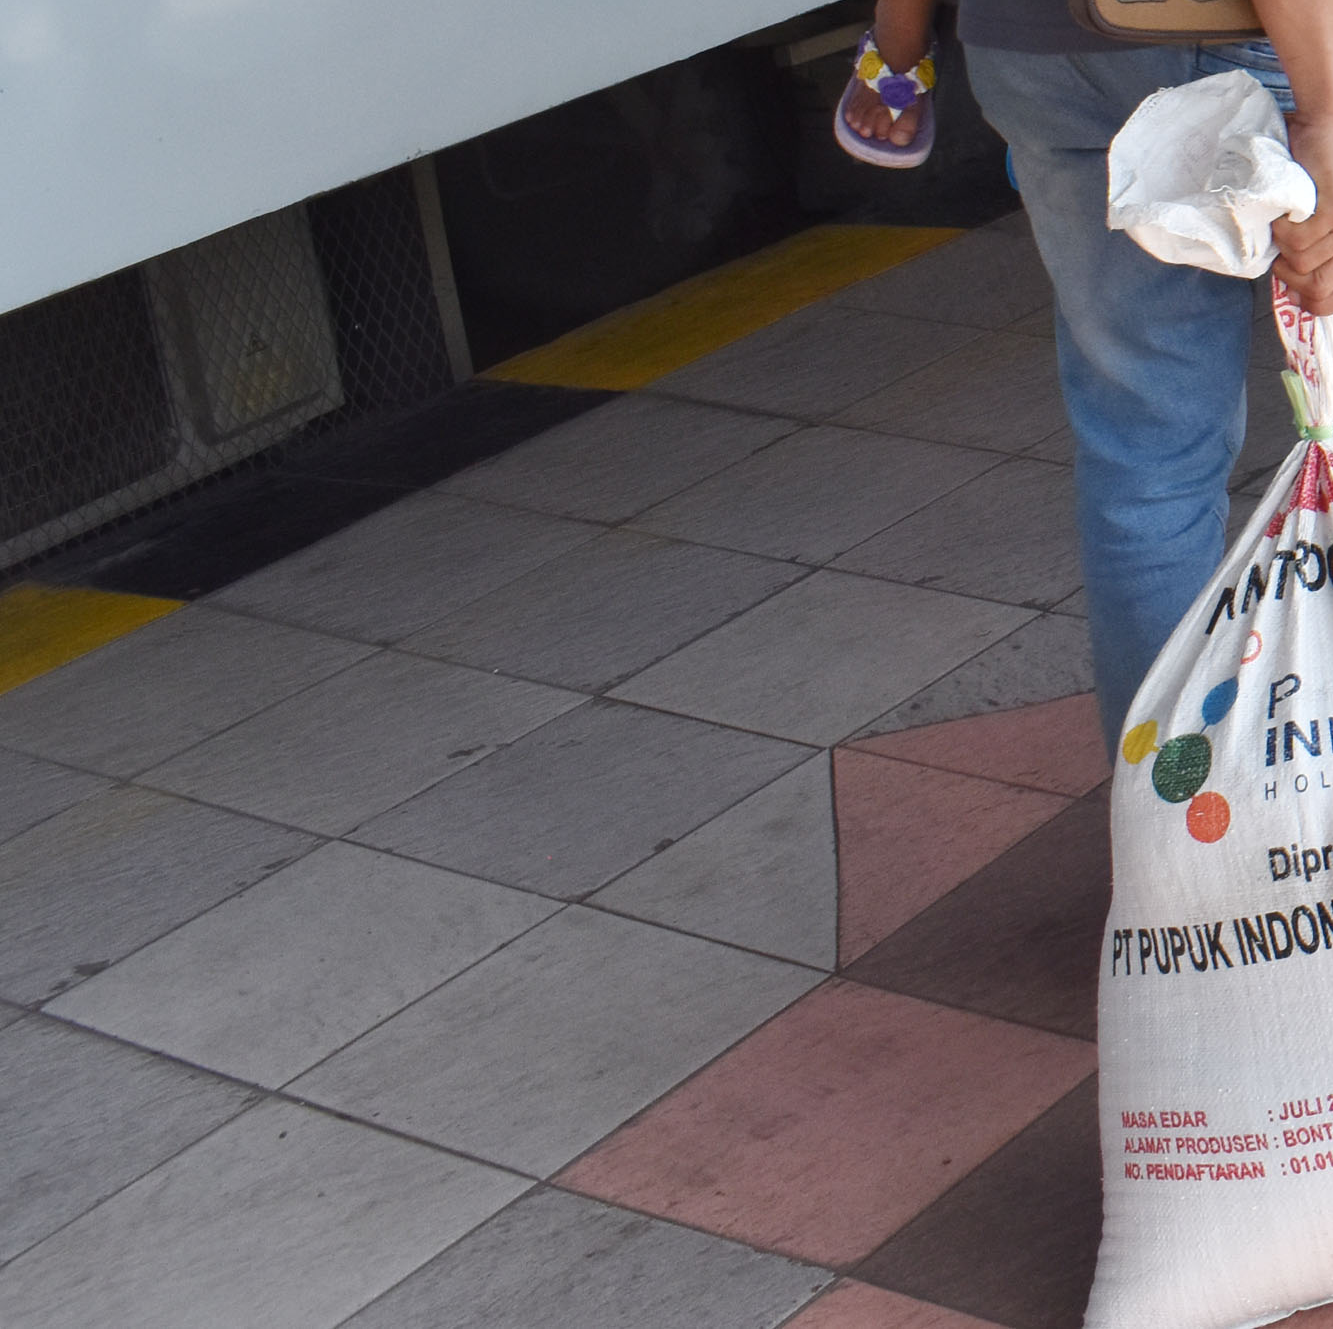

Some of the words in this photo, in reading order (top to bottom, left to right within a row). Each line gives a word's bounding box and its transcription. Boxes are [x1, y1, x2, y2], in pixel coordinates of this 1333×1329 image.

[1112, 928, 1133, 977] PT
[1138, 920, 1235, 976] PUPUK
[1121, 1110, 1158, 1129] MASA
[1161, 1110, 1208, 1129] EDAR
[1279, 1098, 1323, 1121] JULI
[1124, 1137, 1172, 1155] ALAMAT
[1176, 1133, 1269, 1156] PRODUSEN
[1146, 1161, 1266, 1182] PENDAFTARAN
